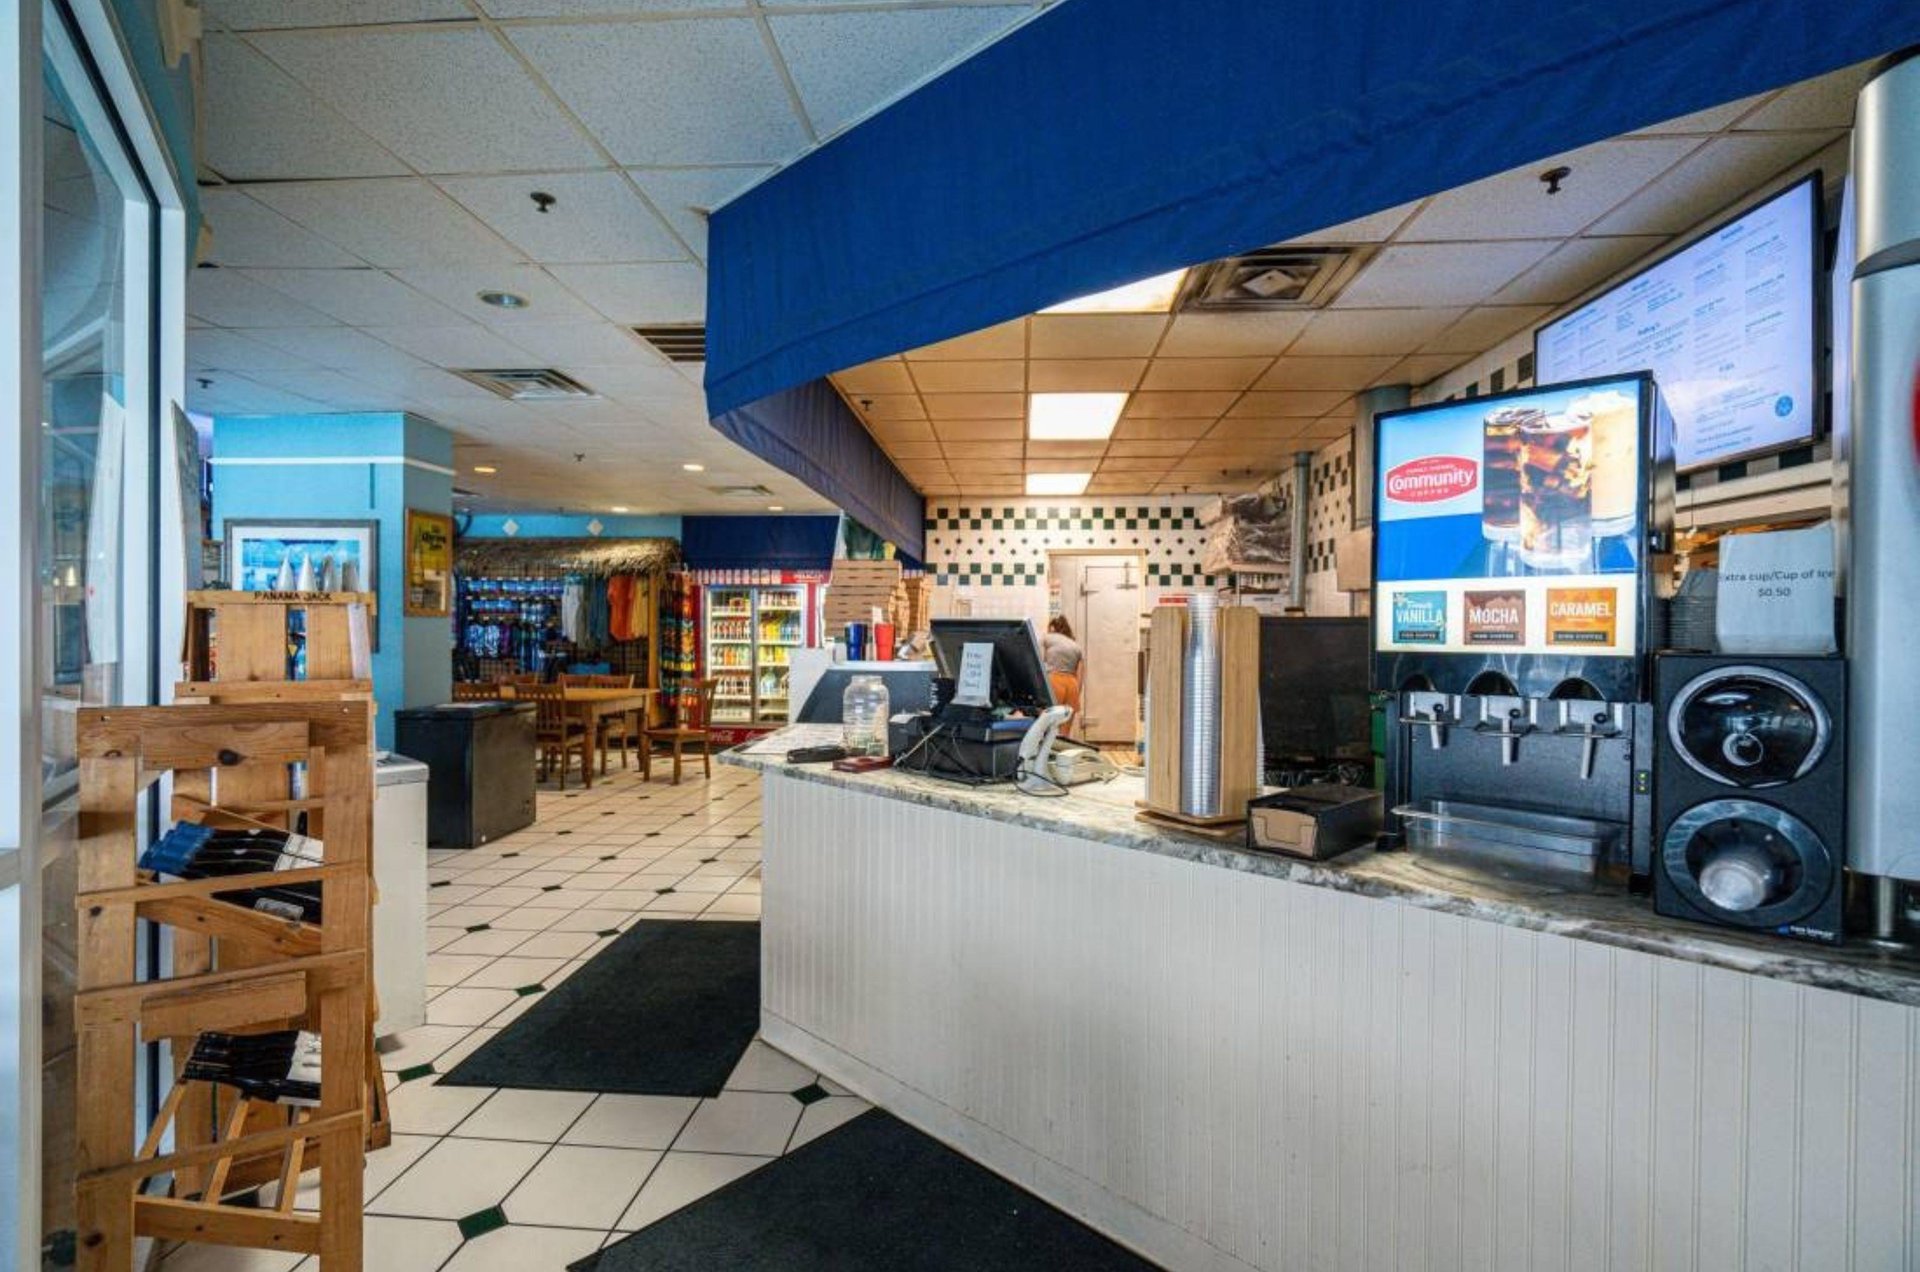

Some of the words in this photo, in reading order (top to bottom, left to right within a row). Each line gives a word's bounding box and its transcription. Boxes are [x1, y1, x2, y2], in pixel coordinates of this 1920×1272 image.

[1389, 468, 1474, 494] Community
[1720, 572, 1746, 582] xtra
[1749, 570, 1798, 582] cup/Cup
[1801, 569, 1814, 579] of
[254, 590, 300, 600] PANAMA
[304, 591, 332, 602] JACK
[1758, 587, 1791, 597] $0.50
[1395, 608, 1444, 625] VANILLA
[1469, 608, 1519, 625] MOCHA
[1550, 601, 1612, 617] CARAMEL
